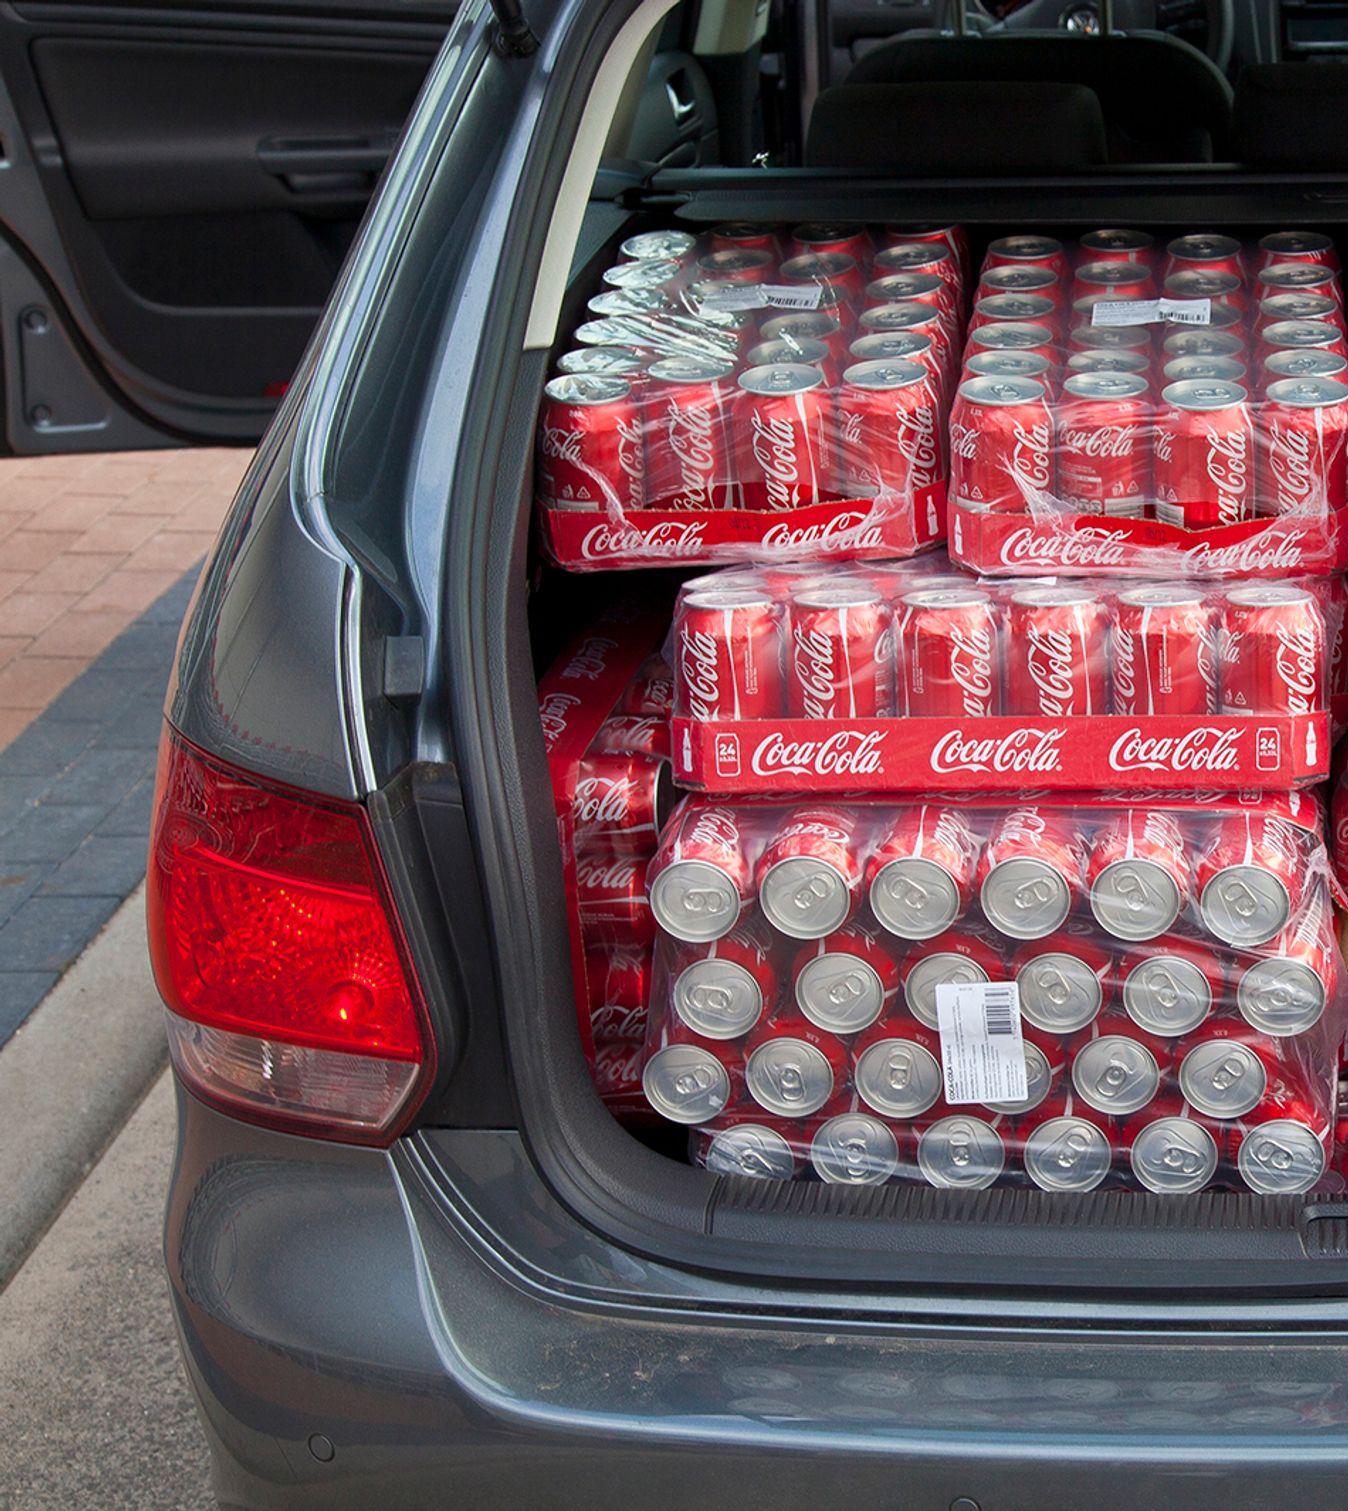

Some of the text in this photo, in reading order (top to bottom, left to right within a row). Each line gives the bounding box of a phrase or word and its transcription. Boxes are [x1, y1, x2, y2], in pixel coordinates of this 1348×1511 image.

[752, 730, 888, 775] Coca-Cola
[930, 729, 1068, 774] Coca-Cola
[1109, 728, 1247, 772] Coca-Cola
[1259, 738, 1276, 751] 24
